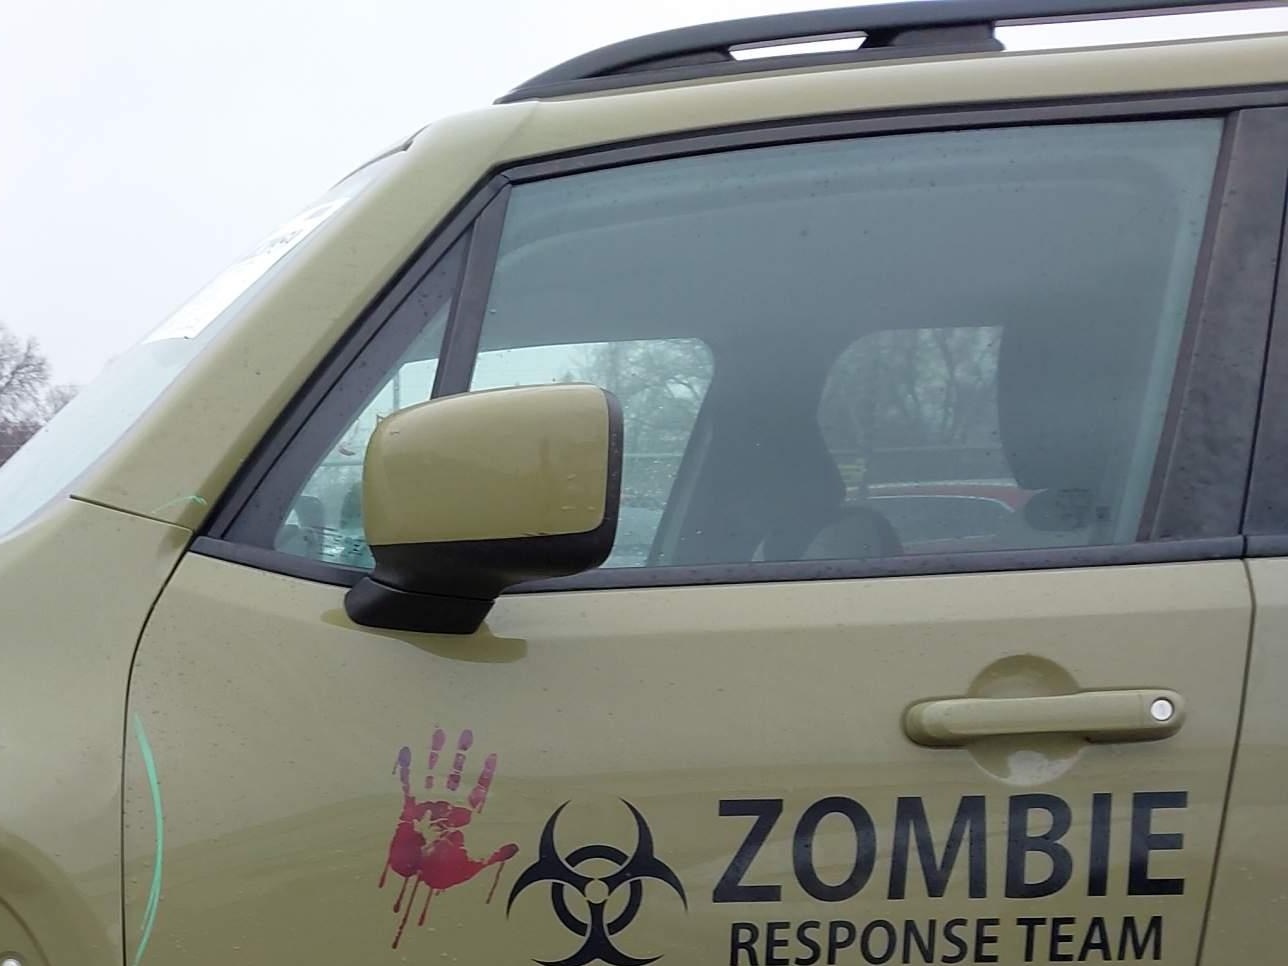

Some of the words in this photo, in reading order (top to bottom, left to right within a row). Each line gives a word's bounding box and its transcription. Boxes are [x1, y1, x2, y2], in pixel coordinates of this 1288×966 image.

[712, 791, 1188, 903] ZOMBIE
[729, 918, 1000, 966] RESPONSE
[1016, 916, 1163, 963] TEAM
